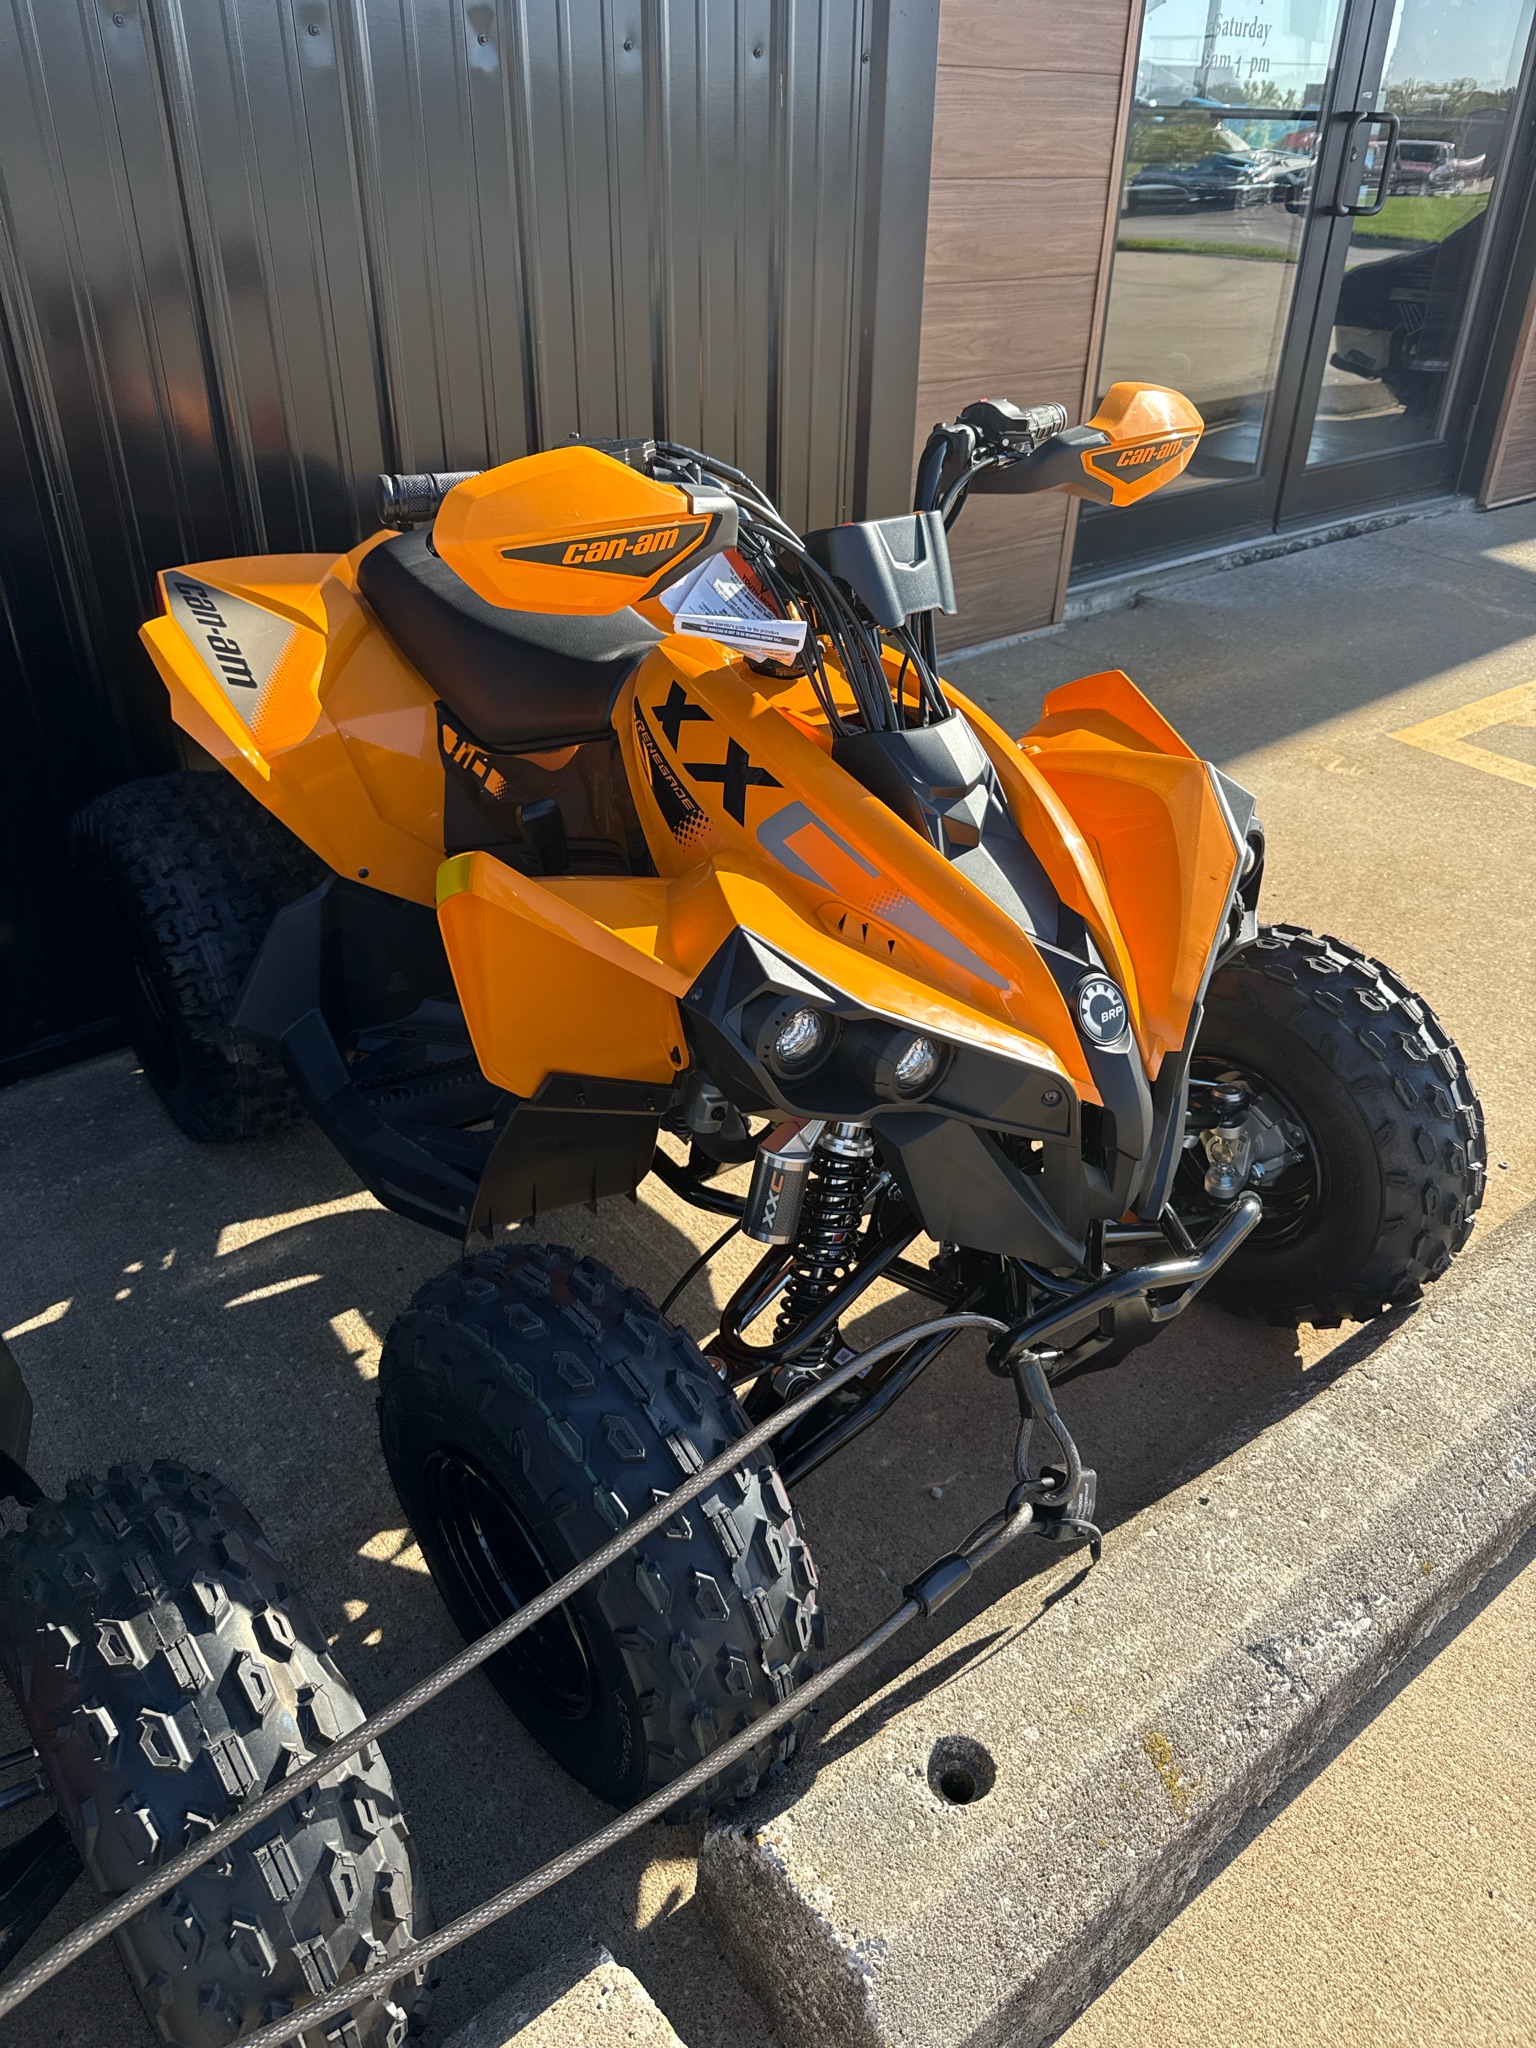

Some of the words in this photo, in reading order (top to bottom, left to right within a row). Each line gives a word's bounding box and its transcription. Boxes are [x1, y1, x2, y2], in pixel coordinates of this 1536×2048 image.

[1214, 12, 1272, 46] Saturday
[1248, 55, 1270, 78] pm
[1116, 439, 1183, 467] can-am
[562, 526, 680, 566] can-am
[742, 574, 760, 597] YOUTH
[175, 582, 258, 689] can-am
[634, 718, 696, 812] RENEGADE
[1101, 1005, 1123, 1023] BRP
[761, 1170, 785, 1229] XXC
